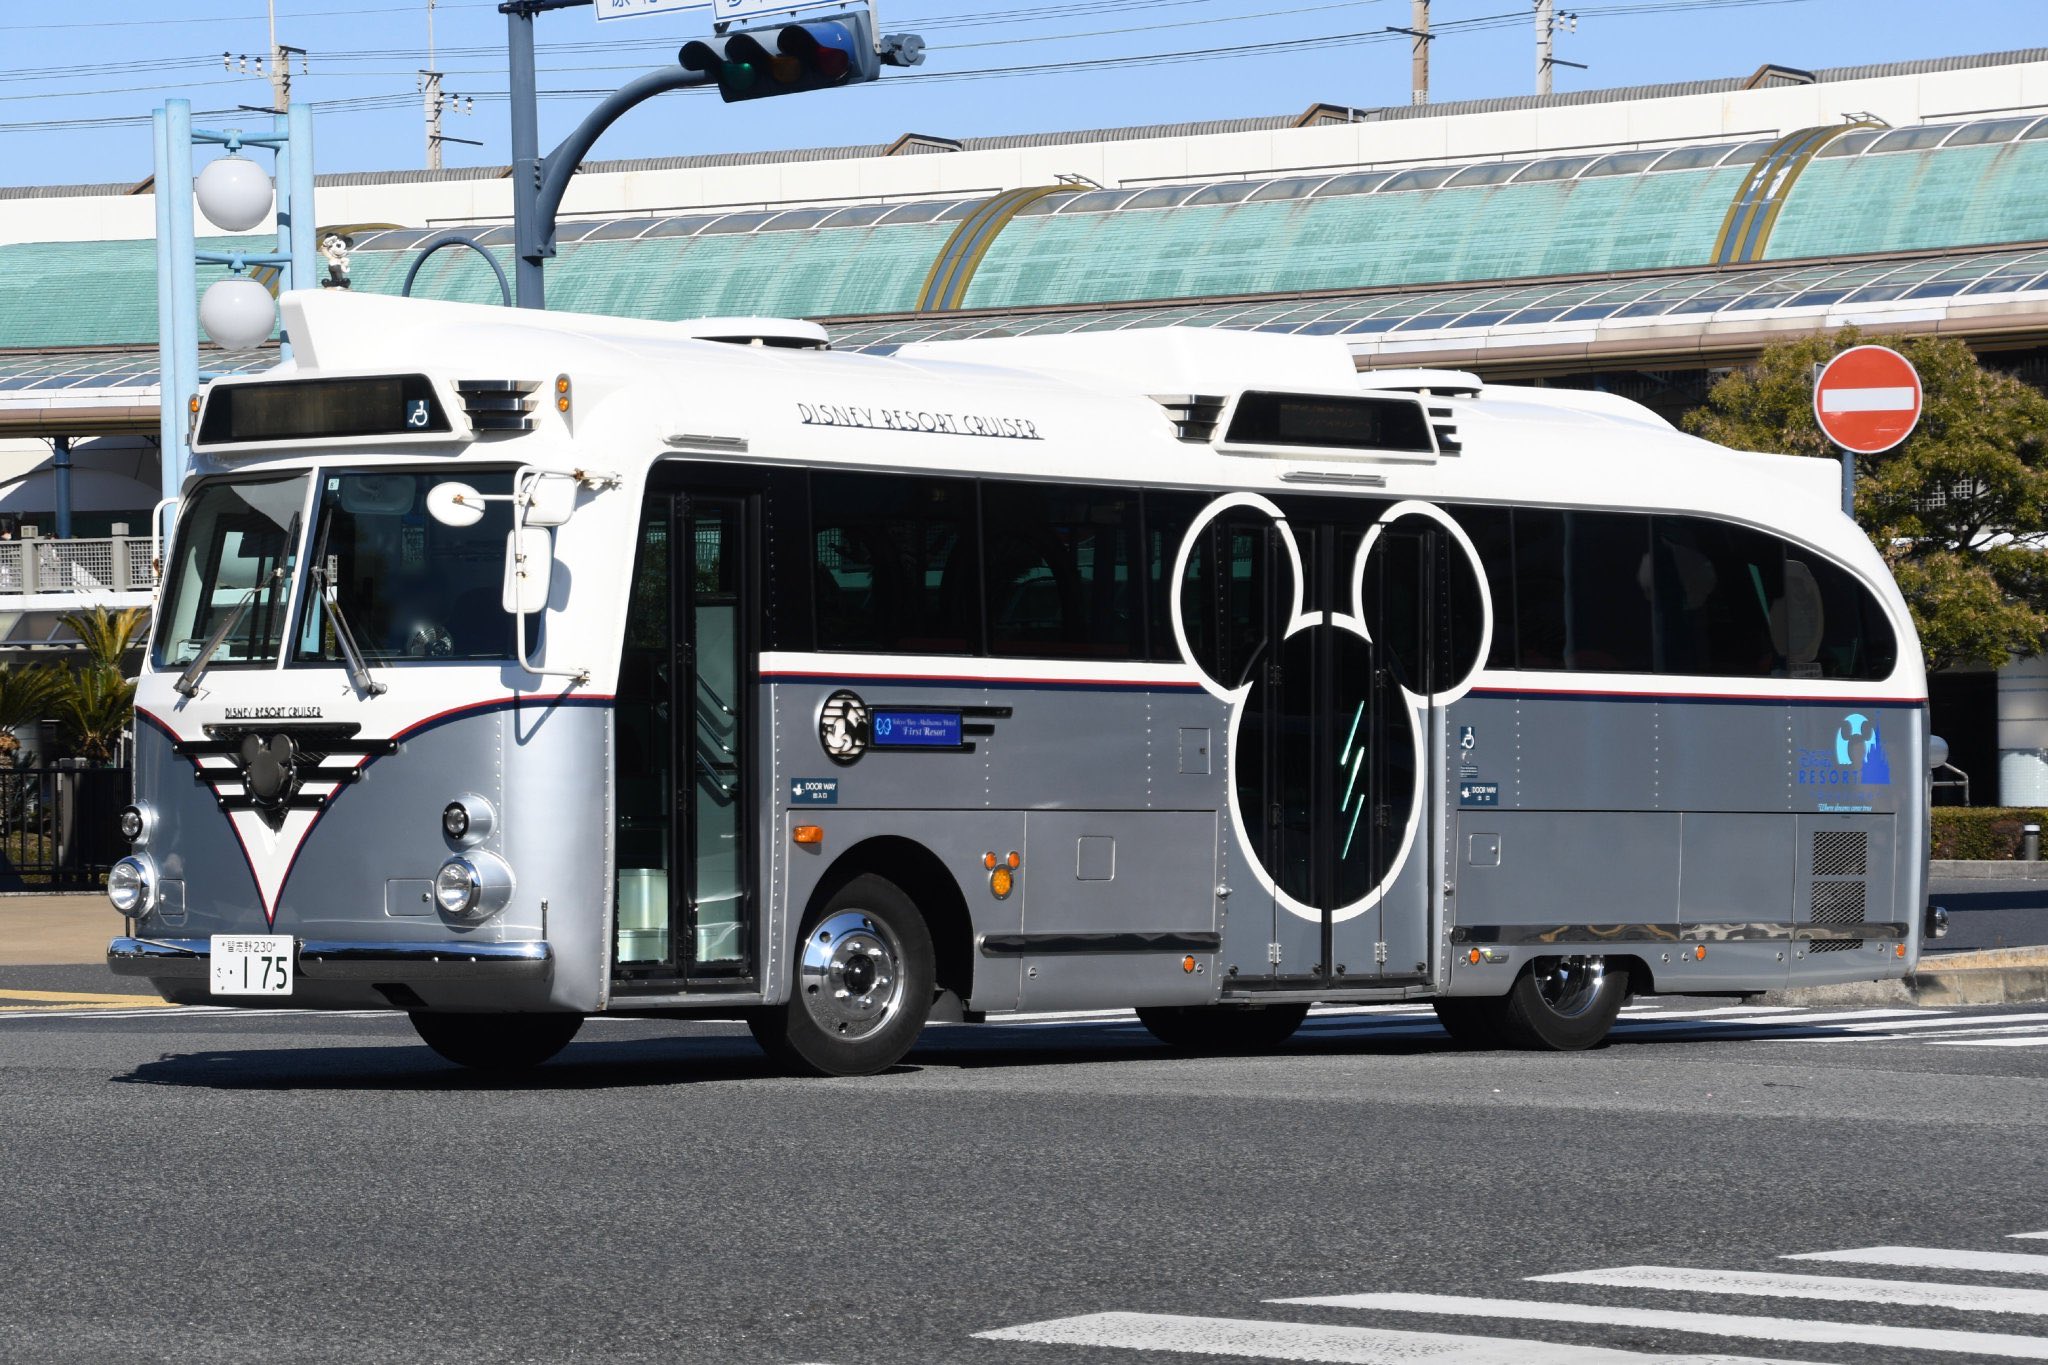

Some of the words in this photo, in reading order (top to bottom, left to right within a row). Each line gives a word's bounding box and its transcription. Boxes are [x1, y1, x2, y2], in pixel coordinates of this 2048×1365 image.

[797, 402, 874, 428] DISNEY
[882, 409, 958, 434] RESORT
[963, 415, 1041, 439] CRUISER
[225, 707, 252, 717] DISNEY
[255, 707, 286, 717] RESORT
[288, 707, 322, 717] CRUISER
[903, 726, 923, 736] First
[923, 727, 946, 737] Resort
[1798, 769, 1859, 785] RESORT
[805, 782, 823, 791] DOOR
[823, 782, 836, 791] WAY
